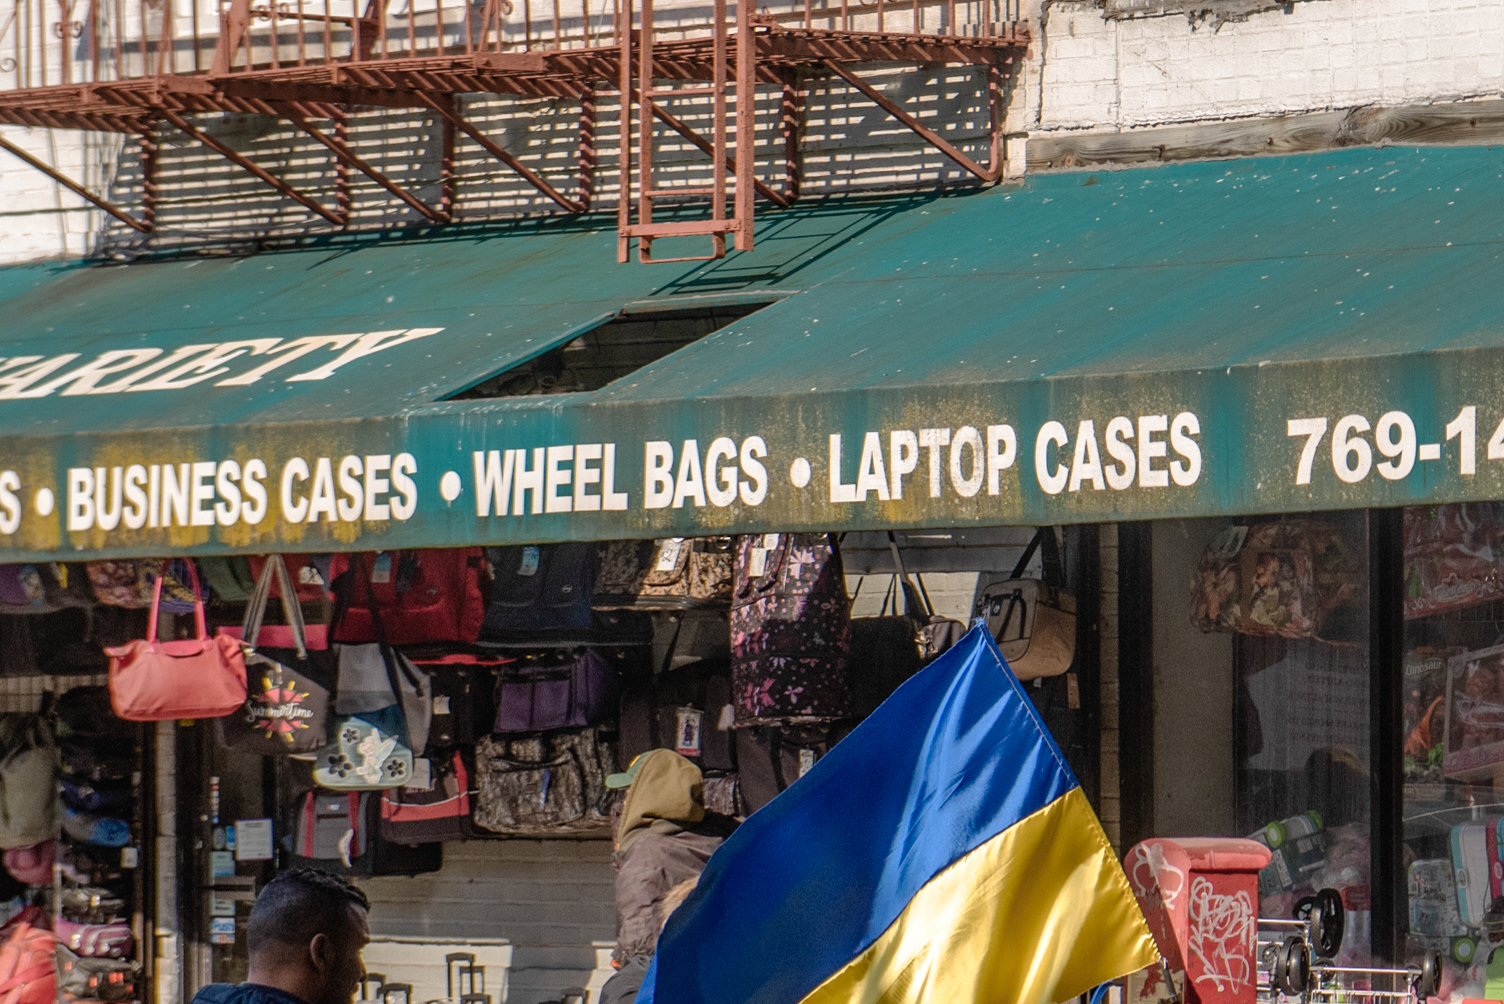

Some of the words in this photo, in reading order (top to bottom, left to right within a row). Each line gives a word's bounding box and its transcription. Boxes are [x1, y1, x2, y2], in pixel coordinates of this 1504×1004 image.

[0, 470, 21, 534] S
[67, 459, 268, 531] BUSINESS
[281, 452, 417, 523] CASES
[474, 443, 628, 517] WHEEL
[644, 436, 768, 509] BAGS
[828, 424, 1017, 503] LAPTOP
[1034, 411, 1202, 495] CASES
